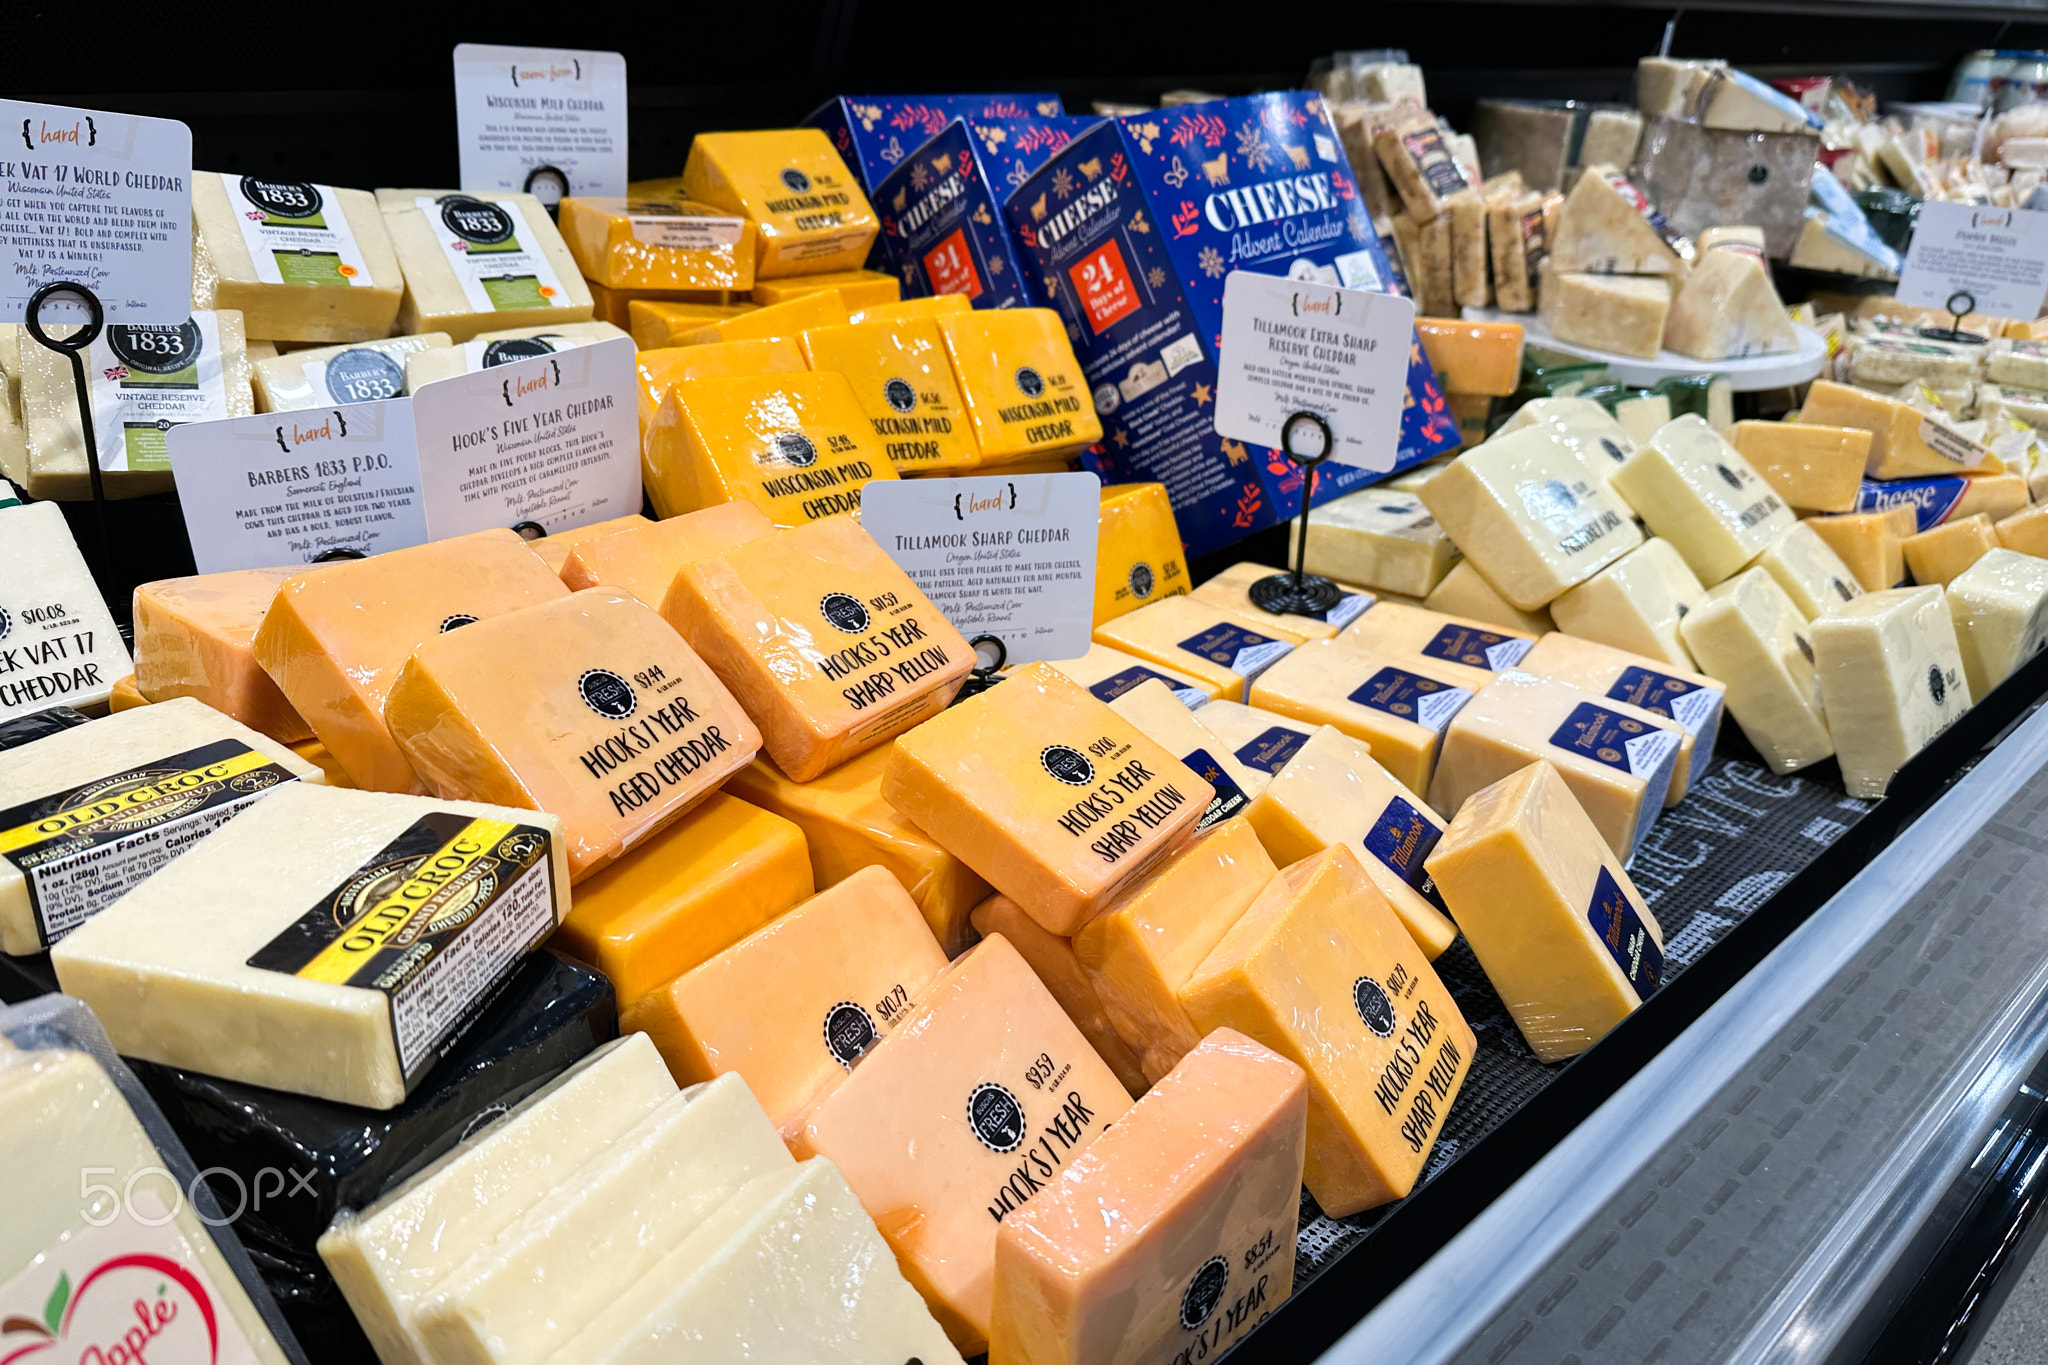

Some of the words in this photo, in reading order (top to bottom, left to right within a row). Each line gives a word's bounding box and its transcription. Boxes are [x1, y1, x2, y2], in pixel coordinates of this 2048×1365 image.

[54, 164, 68, 182] 17
[73, 165, 120, 187] WORLD
[125, 171, 183, 193] CHEDDAR
[86, 186, 112, 200] States
[258, 190, 308, 207] 1833
[1037, 176, 1118, 250] CHEESE
[1204, 171, 1338, 233] CHEESE
[457, 218, 502, 232] 1833
[1229, 231, 1282, 264] Advent
[1283, 219, 1345, 248] Calendar
[37, 249, 45, 259] 17
[48, 250, 56, 260] IS
[1082, 253, 1114, 292] 24
[127, 333, 184, 355] 1833
[115, 392, 160, 401] VINTAGE
[162, 393, 206, 402] RESERVE
[138, 402, 186, 410] CHEDDAR
[344, 379, 395, 400] 1833
[158, 421, 170, 429] 20
[924, 418, 952, 434] MILD
[998, 403, 1055, 424] WISCONSIN
[1054, 396, 1080, 414] MILD
[1026, 420, 1074, 443] CHEDDAR
[886, 441, 941, 460] CHEDDAR
[247, 466, 310, 487] BARBERS
[314, 459, 347, 478] 1833
[353, 453, 392, 472] P.D.O.
[762, 467, 841, 498] WISCONSIN
[837, 461, 872, 482] MILD
[896, 534, 967, 550] TILLAMOOK
[972, 531, 1013, 547] SHARP
[1017, 528, 1070, 544] CHEDDAR
[21, 604, 66, 624] $10.08
[829, 602, 861, 622] FRESH
[23, 637, 67, 665] VAT
[73, 632, 93, 655] 17
[818, 641, 877, 681] HOOKS
[869, 636, 890, 656] 5
[881, 618, 928, 648] YEAR
[0, 663, 103, 706] CHEDDAR
[633, 664, 666, 689] $9.44
[843, 672, 895, 710] SHARP
[890, 645, 950, 684] YELLOW
[588, 682, 626, 707] FRESH
[640, 719, 658, 742] 1
[650, 696, 700, 735] YEAR
[1574, 712, 1608, 749] Tillamook
[1052, 754, 1084, 776] FRESH
[1252, 733, 1294, 764] Tillamook
[83, 772, 147, 796] AUSTRALIAN
[608, 772, 662, 817] AGED
[654, 726, 732, 785] CHEDDAR
[1109, 760, 1155, 793] YEAR
[37, 801, 123, 834] OLD
[124, 764, 230, 805] CROC
[77, 807, 139, 835] GRAND
[142, 785, 217, 809] RESERVE
[1100, 785, 1125, 804] 5
[1221, 793, 1244, 813] CHEESE
[110, 814, 166, 831] CHEDDAR
[166, 797, 202, 821] CHEESE
[1057, 793, 1113, 837] HOOKS
[1091, 820, 1142, 863] SHARP
[1129, 783, 1186, 829] YELLOW
[38, 848, 112, 880] Nutrition
[116, 830, 160, 853] Facts
[163, 819, 202, 837] Servings:
[203, 807, 232, 823] Varied,
[51, 879, 68, 889] oz.
[71, 866, 99, 883] (28g)
[165, 827, 211, 848] Calories
[1389, 816, 1424, 871] Tillamook
[88, 880, 123, 897] Sodium
[339, 867, 390, 908] AUSTRALIAN
[342, 904, 411, 953] OLD
[402, 838, 482, 902] CROC
[397, 903, 433, 944] GRAND
[432, 860, 493, 906] RESERVE
[48, 905, 84, 922] Protein
[429, 904, 478, 932] CHEDDAR
[473, 920, 501, 950] Calories
[501, 901, 522, 922] 120,
[1606, 891, 1624, 954] Tillamook
[396, 963, 443, 1008] Nutrition
[444, 934, 472, 963] Facts
[875, 984, 908, 1022] $10.79
[833, 1016, 869, 1054] FRESH
[1407, 1000, 1438, 1050] YEAR
[1401, 1036, 1420, 1065] 5
[1025, 1052, 1056, 1090] $9.59
[1374, 1049, 1413, 1116] HOOKS
[1401, 1089, 1436, 1153] SHARP
[1424, 1035, 1462, 1102] YELLOW
[978, 1096, 1014, 1139] FRESH
[1046, 1091, 1094, 1150] YEAR
[1039, 1136, 1060, 1165] 1
[1226, 1275, 1268, 1333] YEAR
